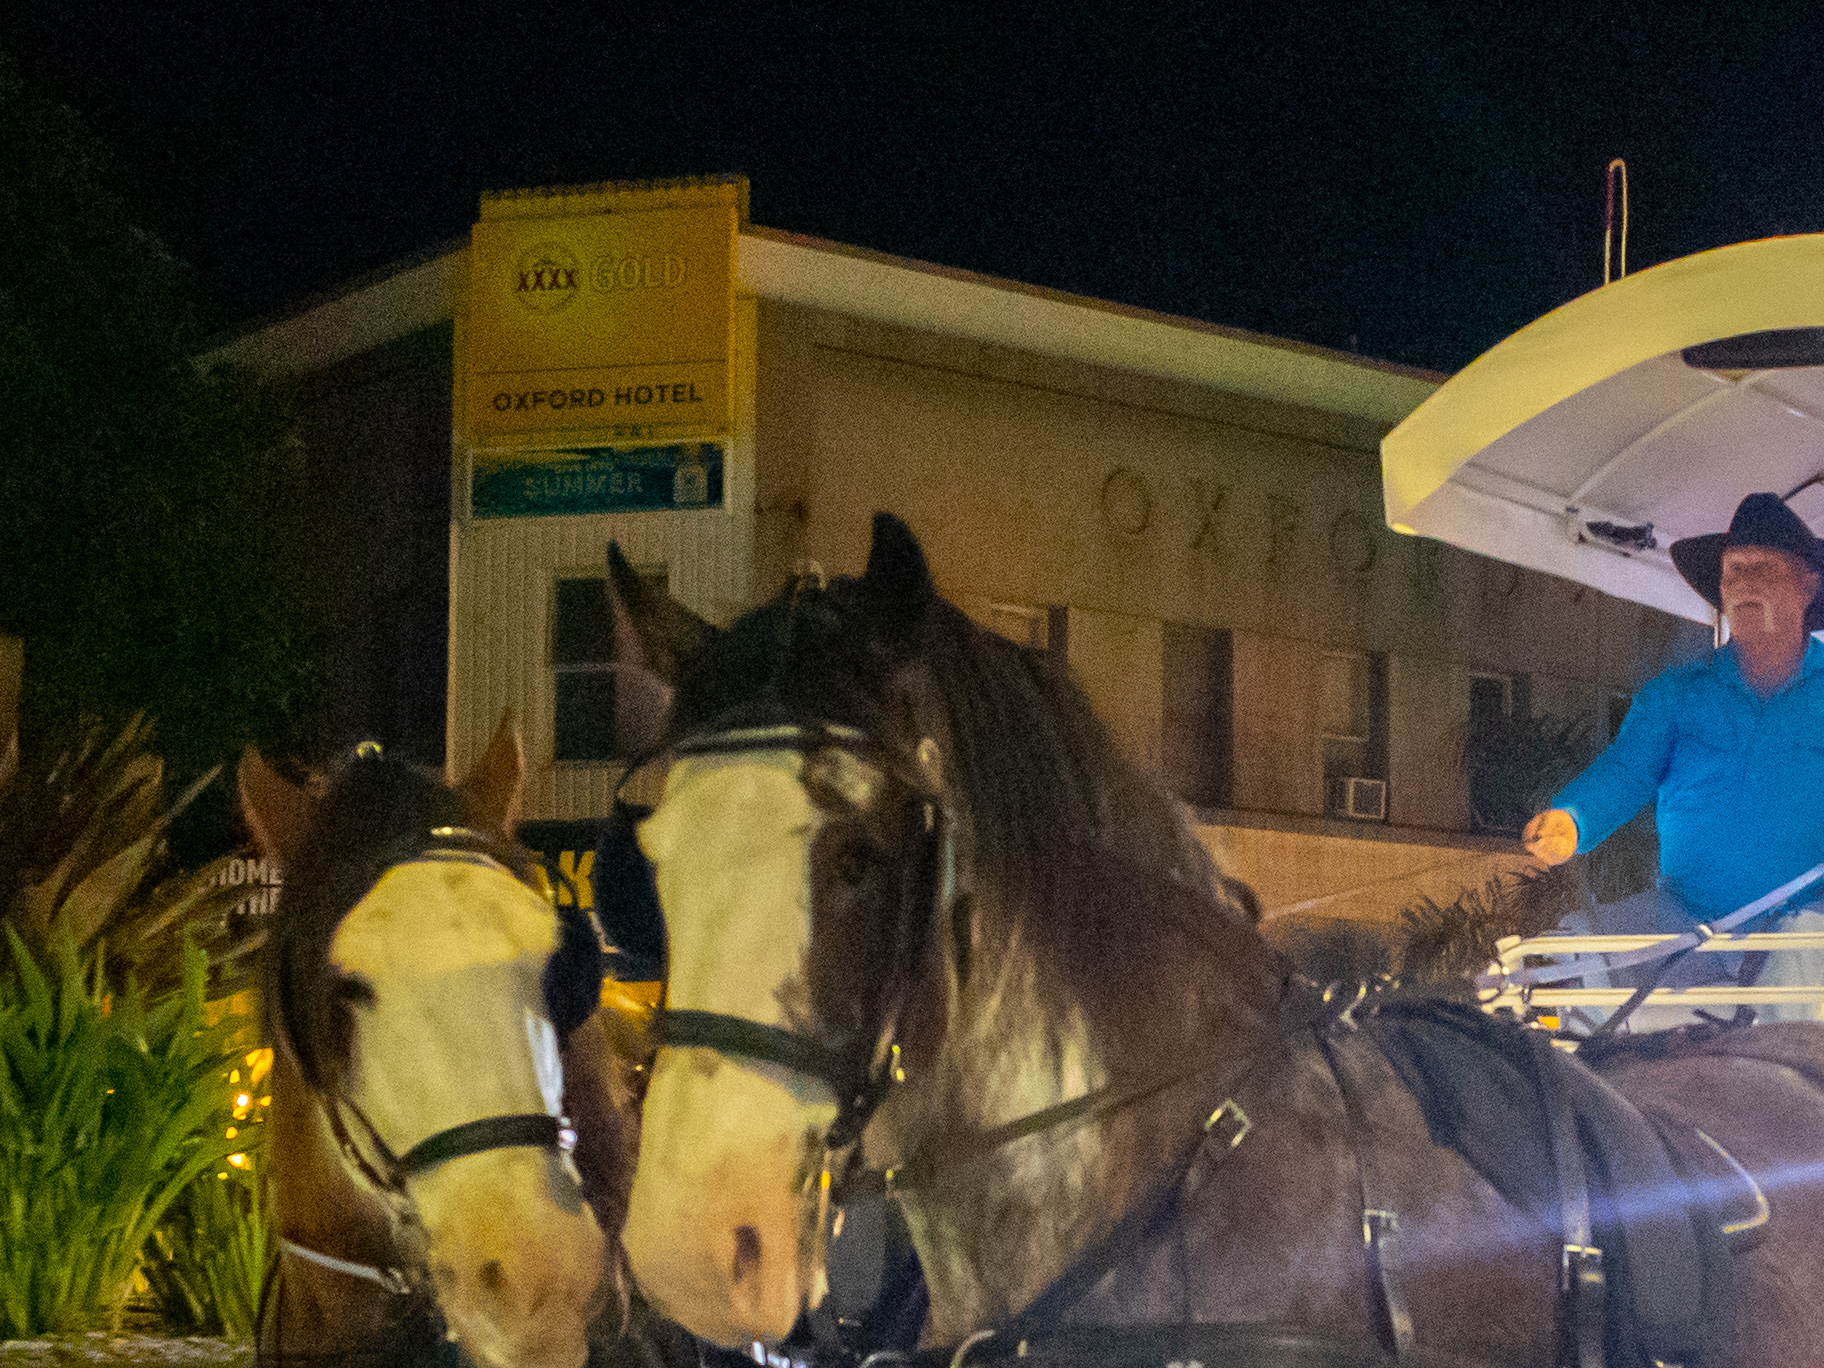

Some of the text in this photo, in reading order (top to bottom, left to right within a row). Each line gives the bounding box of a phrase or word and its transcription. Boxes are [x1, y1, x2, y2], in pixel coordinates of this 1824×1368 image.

[516, 254, 687, 294] XXXX GOLD
[492, 383, 703, 412] OXFORD HOTEL
